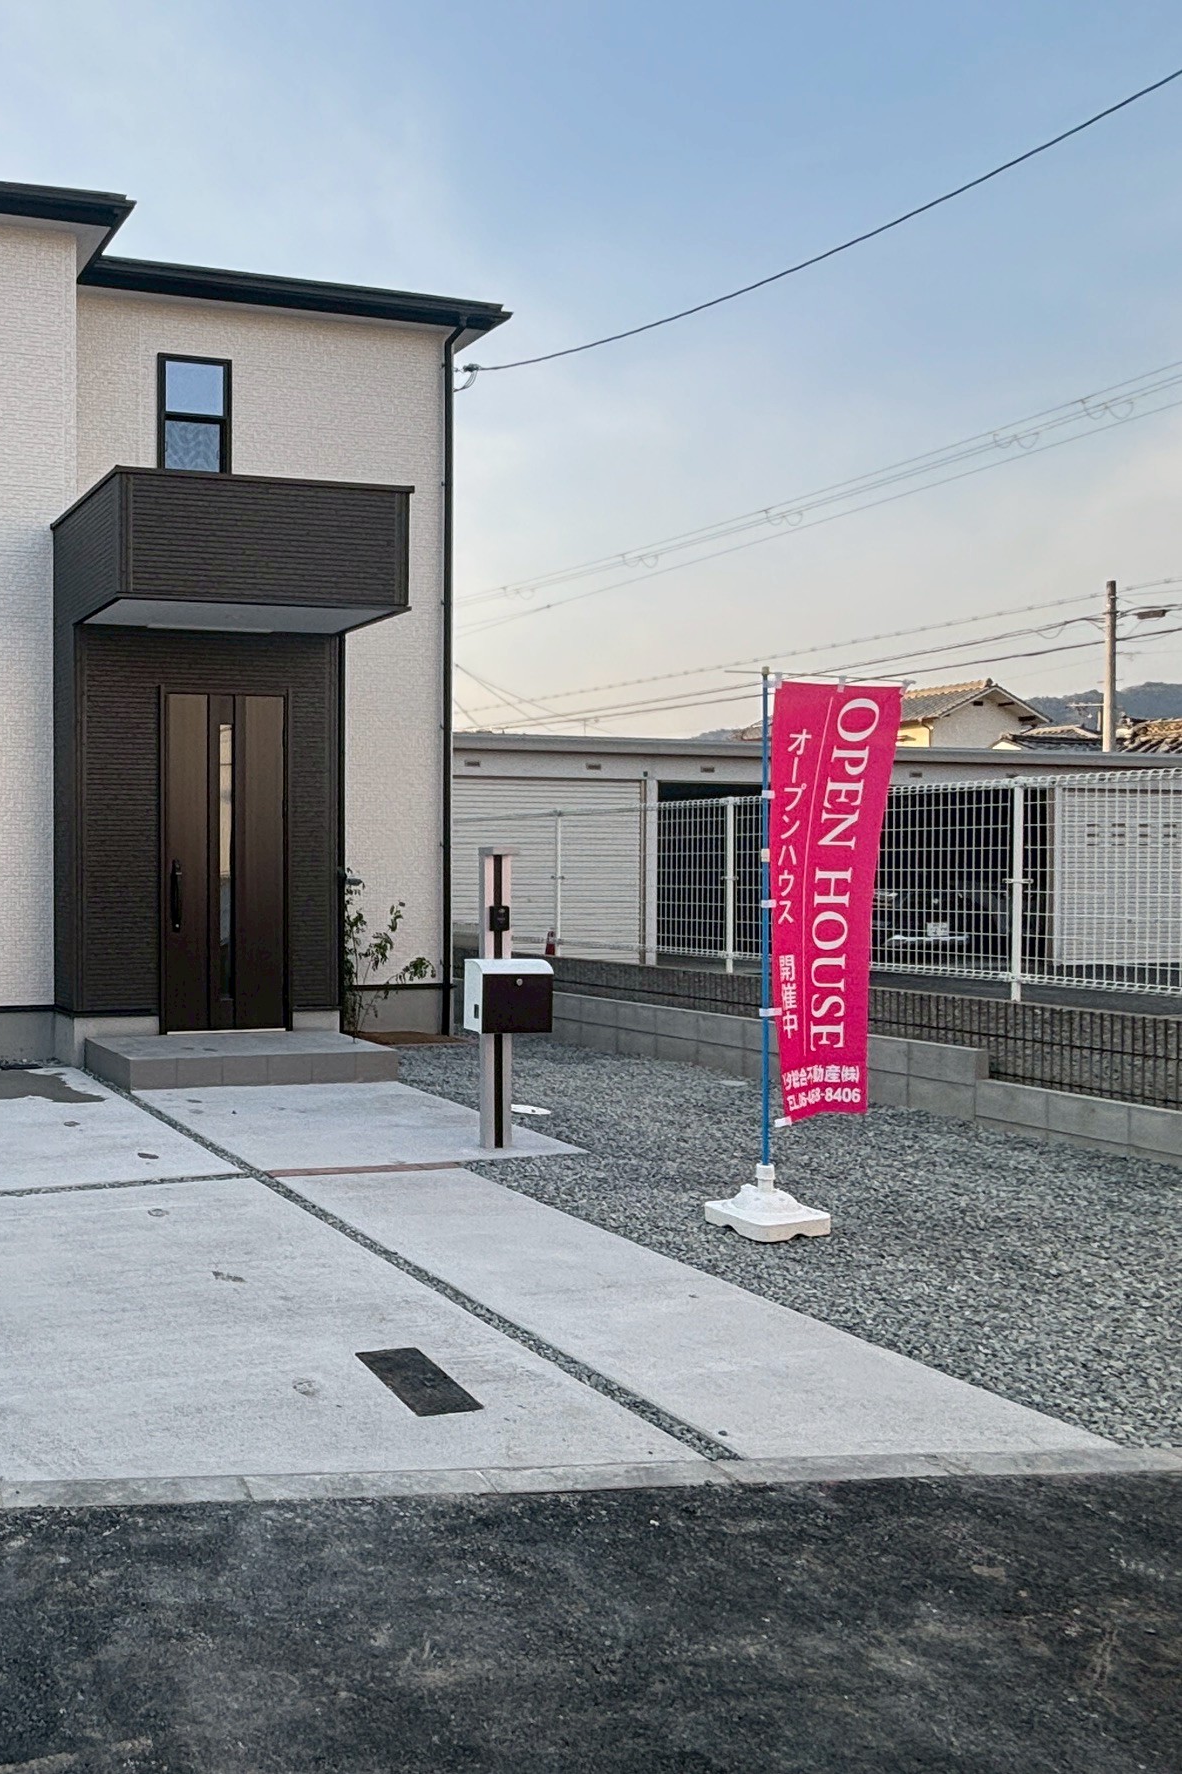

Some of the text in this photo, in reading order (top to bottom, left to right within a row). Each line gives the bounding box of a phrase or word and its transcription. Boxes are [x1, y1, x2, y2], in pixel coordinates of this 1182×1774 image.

[777, 728, 812, 1039] オープンハウス 開催中
[809, 697, 880, 1052] OPEN HOUSE
